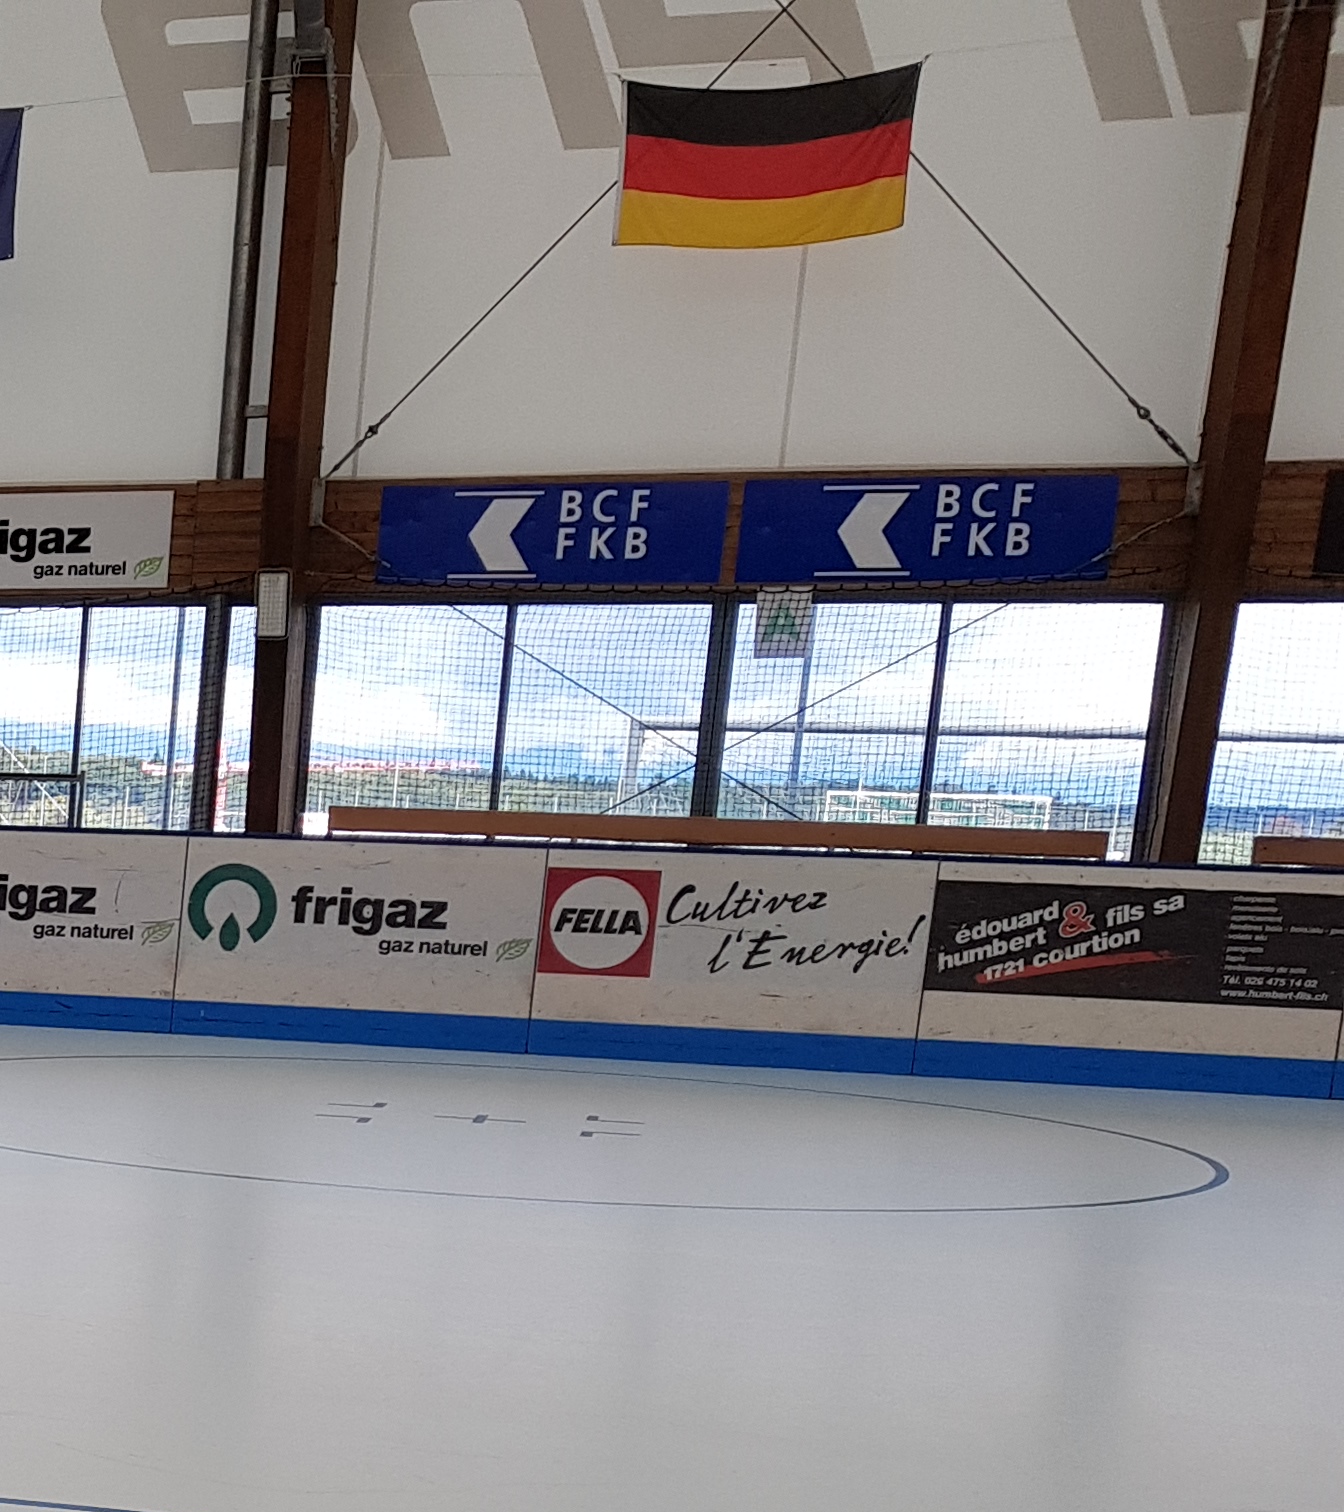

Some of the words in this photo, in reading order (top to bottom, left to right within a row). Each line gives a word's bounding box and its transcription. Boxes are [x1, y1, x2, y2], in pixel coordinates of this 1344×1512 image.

[559, 489, 651, 523] BCF
[935, 483, 1035, 518] BCF
[555, 526, 648, 560] FKB
[931, 522, 1031, 557] FKB
[33, 563, 63, 579] gaz
[67, 561, 126, 576] naturel
[291, 886, 448, 936] frigaz
[666, 881, 828, 924] Cultivez
[955, 900, 1060, 945] édouard
[1059, 901, 1096, 937] &
[1105, 902, 1145, 928] fils
[1153, 895, 1185, 916] sa
[33, 924, 66, 940] gaz
[71, 924, 134, 940] naturel
[554, 907, 643, 935] FELLA
[378, 939, 414, 957] gaz
[419, 940, 488, 957] naturel
[938, 927, 1047, 972] humbert
[983, 961, 1025, 981] 1721
[1032, 928, 1141, 969] courtion
